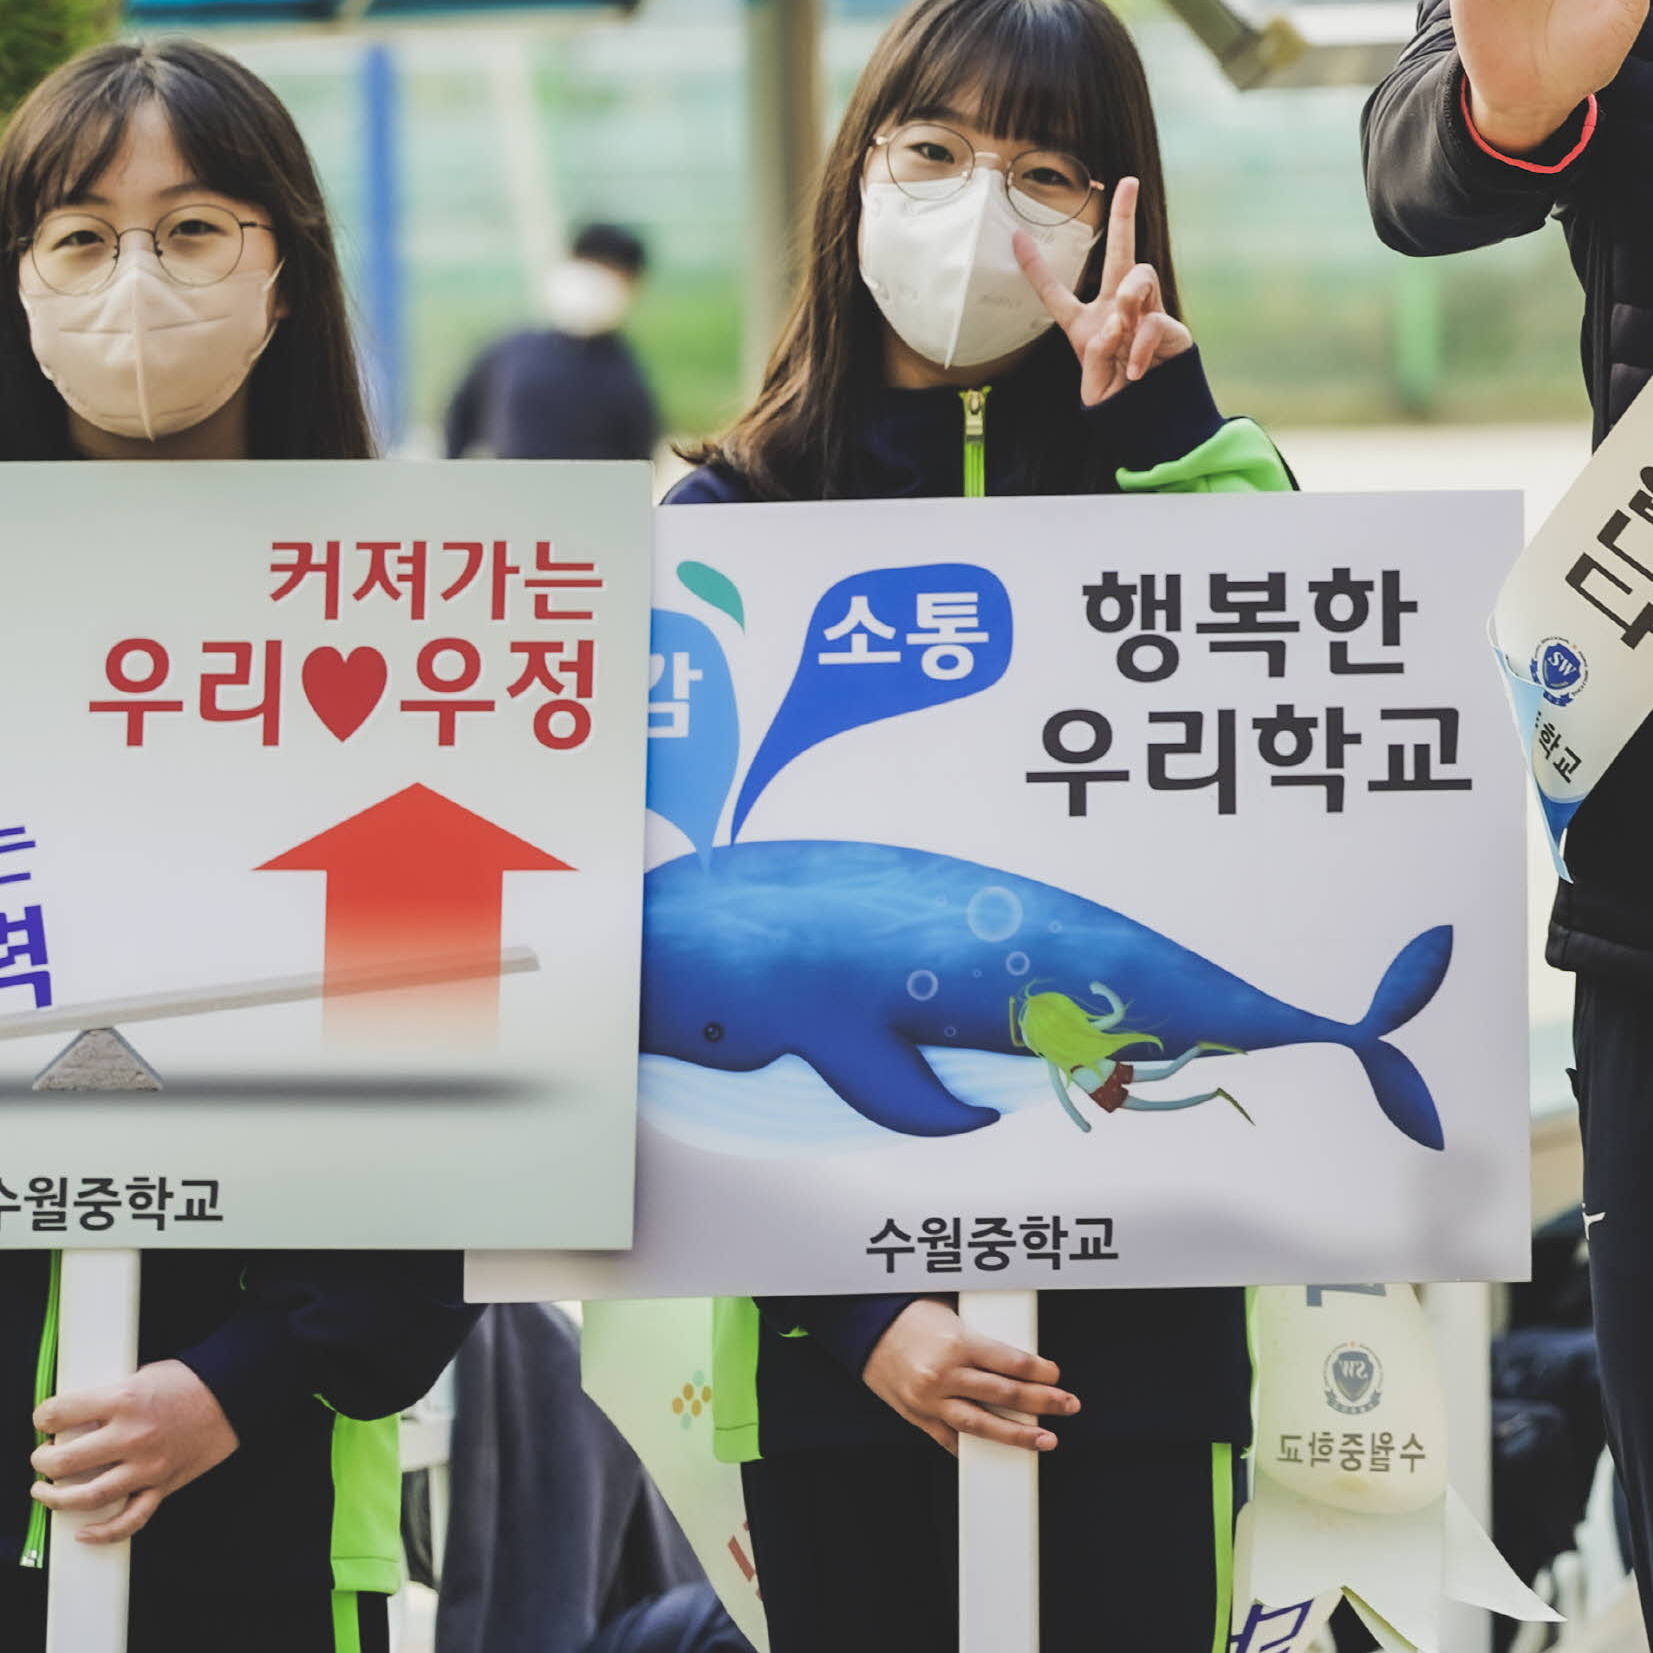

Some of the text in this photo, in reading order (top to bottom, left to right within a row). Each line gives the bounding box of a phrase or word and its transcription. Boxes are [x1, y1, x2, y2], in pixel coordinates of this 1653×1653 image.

[270, 540, 603, 621] 커져가는
[1081, 566, 1419, 684] 행복한
[817, 590, 990, 680] 소통
[1547, 651, 1577, 678] SW
[88, 637, 597, 751] 우리 우정
[1025, 703, 1474, 818] 우리학교
[866, 1215, 1120, 1274] 수월중학교
